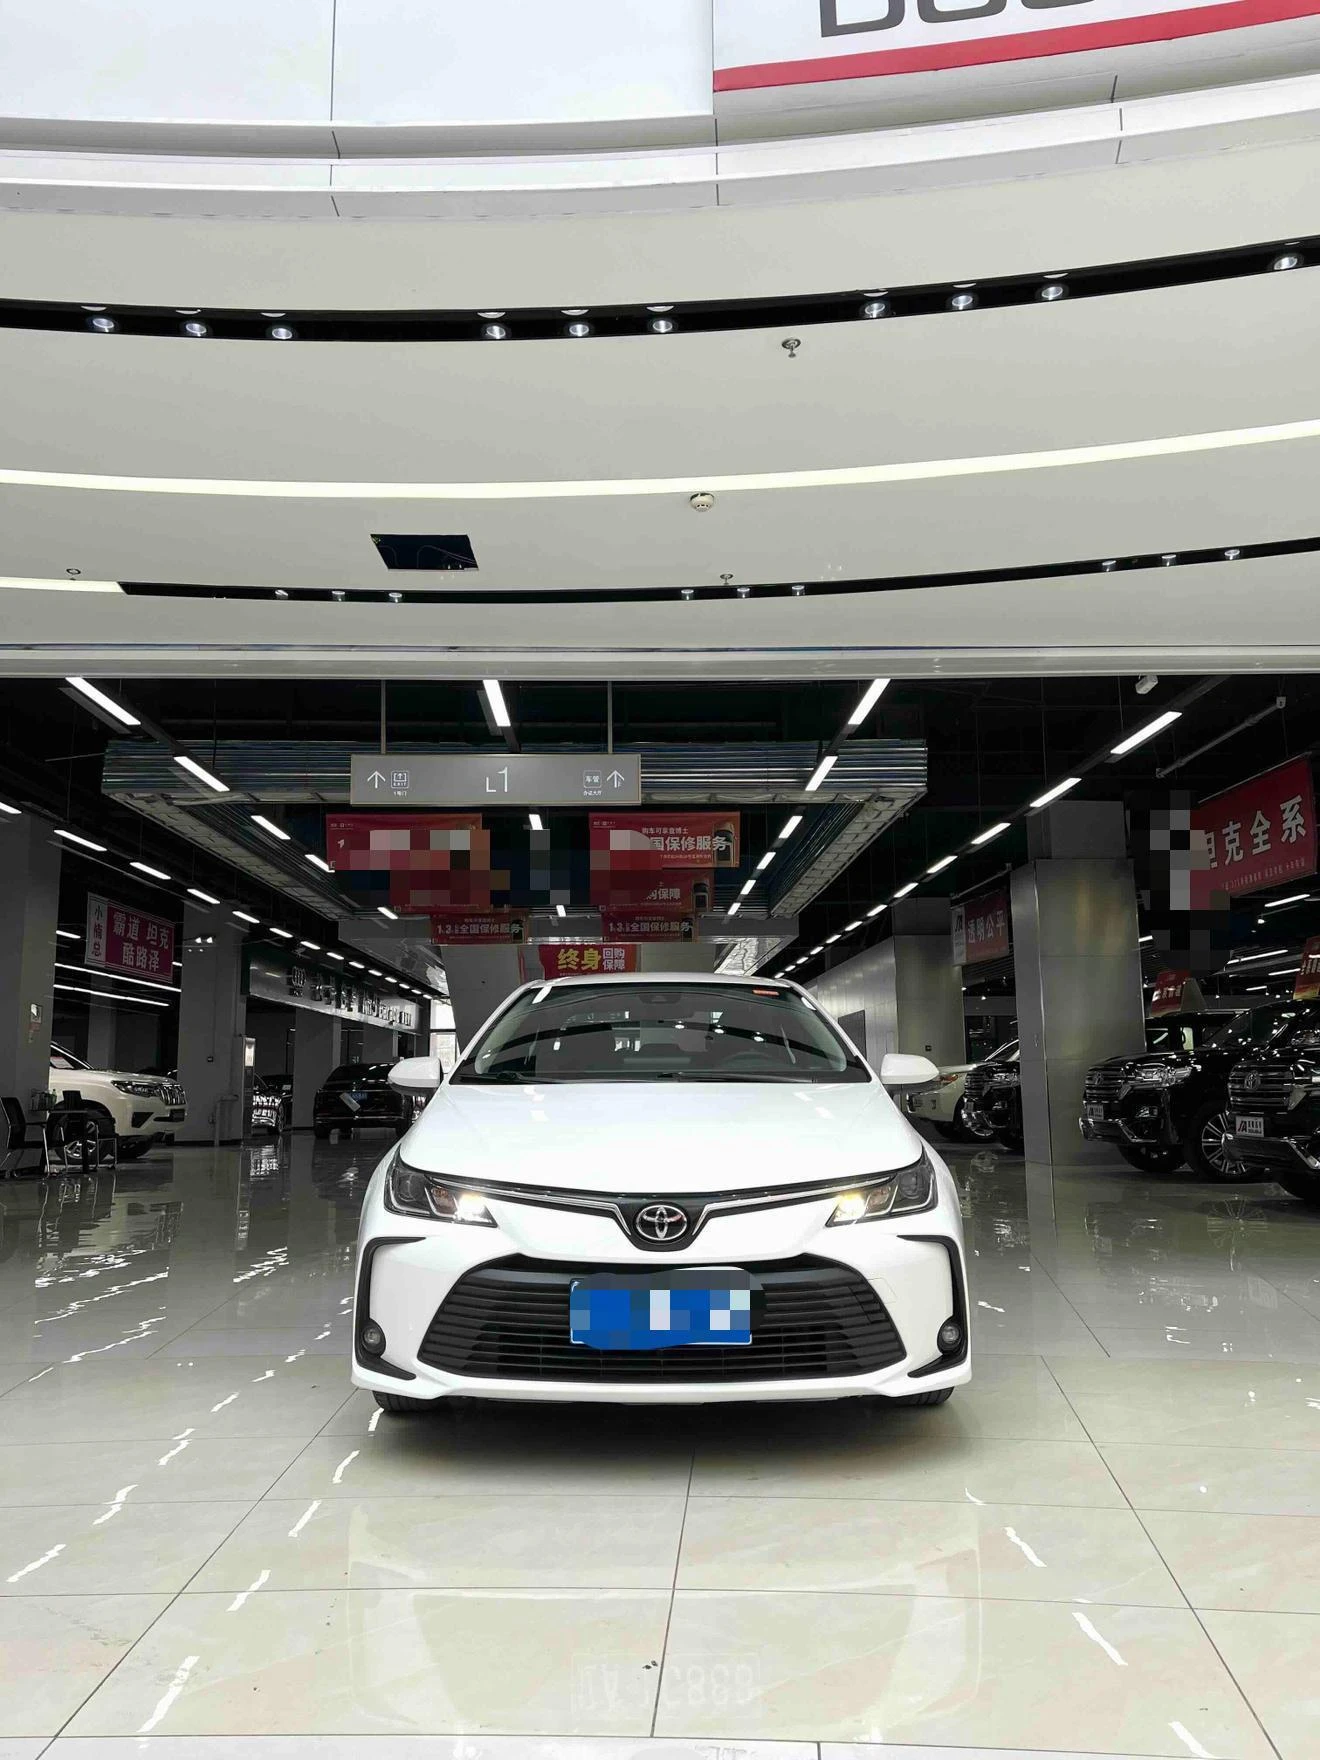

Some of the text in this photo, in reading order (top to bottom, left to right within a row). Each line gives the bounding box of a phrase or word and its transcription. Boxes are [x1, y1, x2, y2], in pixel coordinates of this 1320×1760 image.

[485, 766, 509, 793] L1
[585, 775, 600, 784] 车管
[112, 911, 170, 950] 霸道 坦克
[967, 909, 1006, 944] 透明公平
[122, 942, 160, 972] 酷路泽
[557, 947, 602, 971] 终身
[602, 947, 625, 959] 回购
[602, 959, 625, 971] 保障
